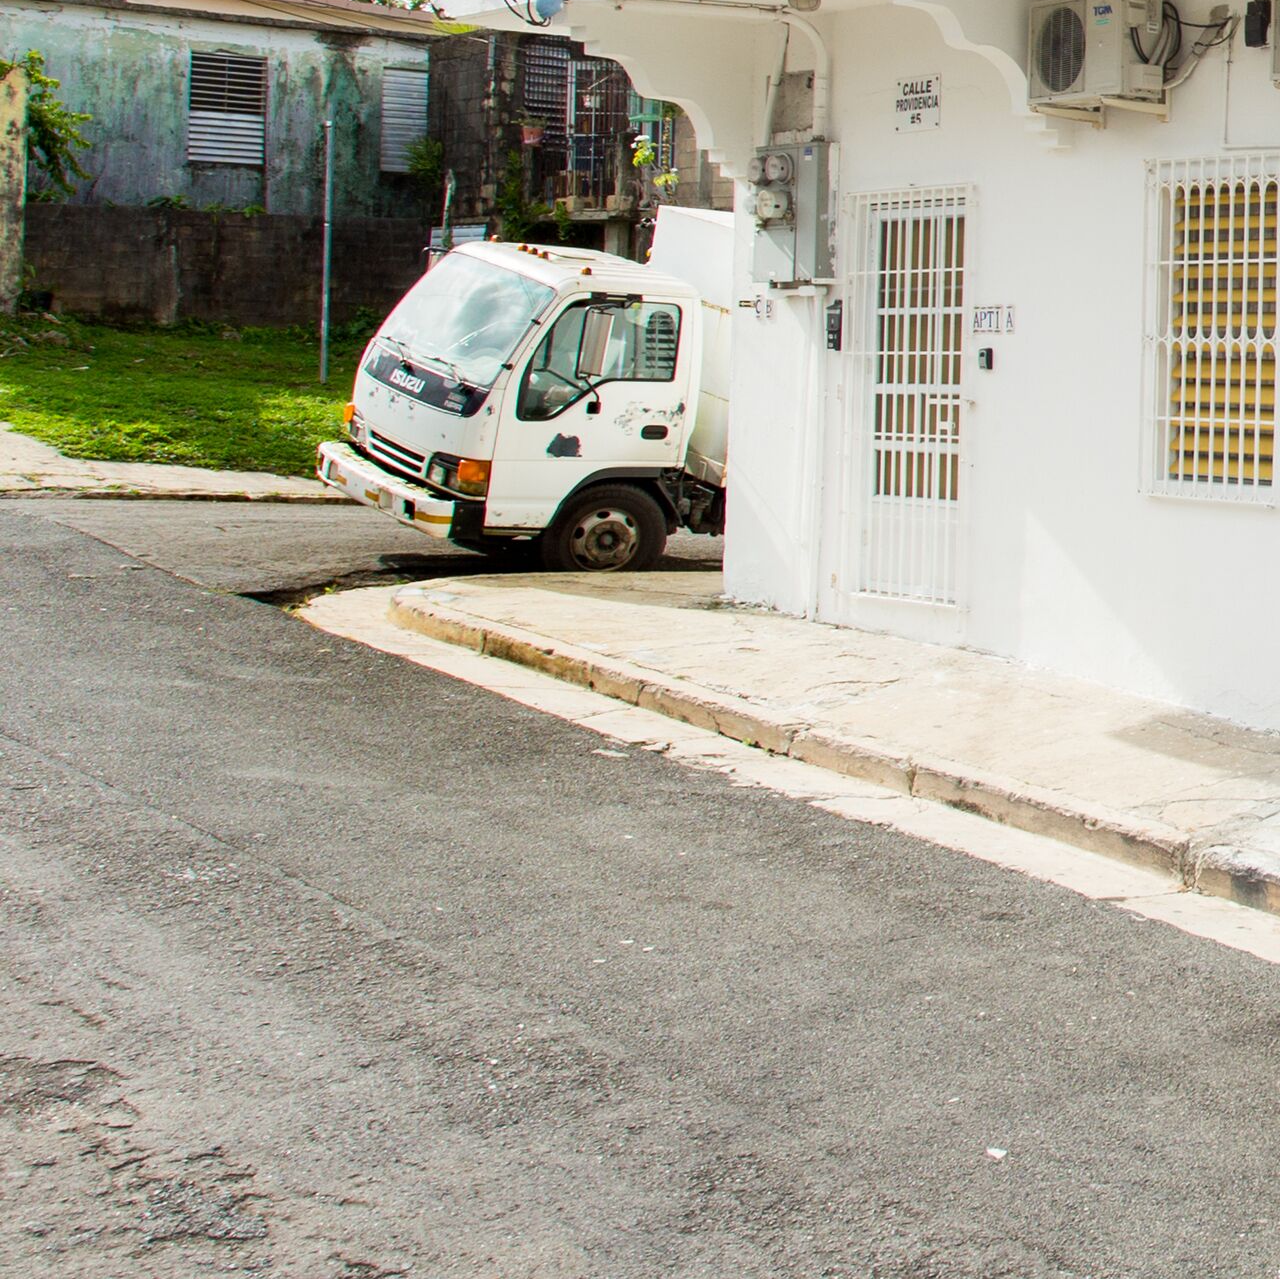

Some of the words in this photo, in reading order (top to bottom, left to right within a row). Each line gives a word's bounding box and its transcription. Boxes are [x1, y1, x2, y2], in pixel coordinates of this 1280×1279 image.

[902, 80, 932, 96] CALLE
[896, 95, 938, 112] PROVIDENCIA
[390, 368, 425, 393] ISUZU
